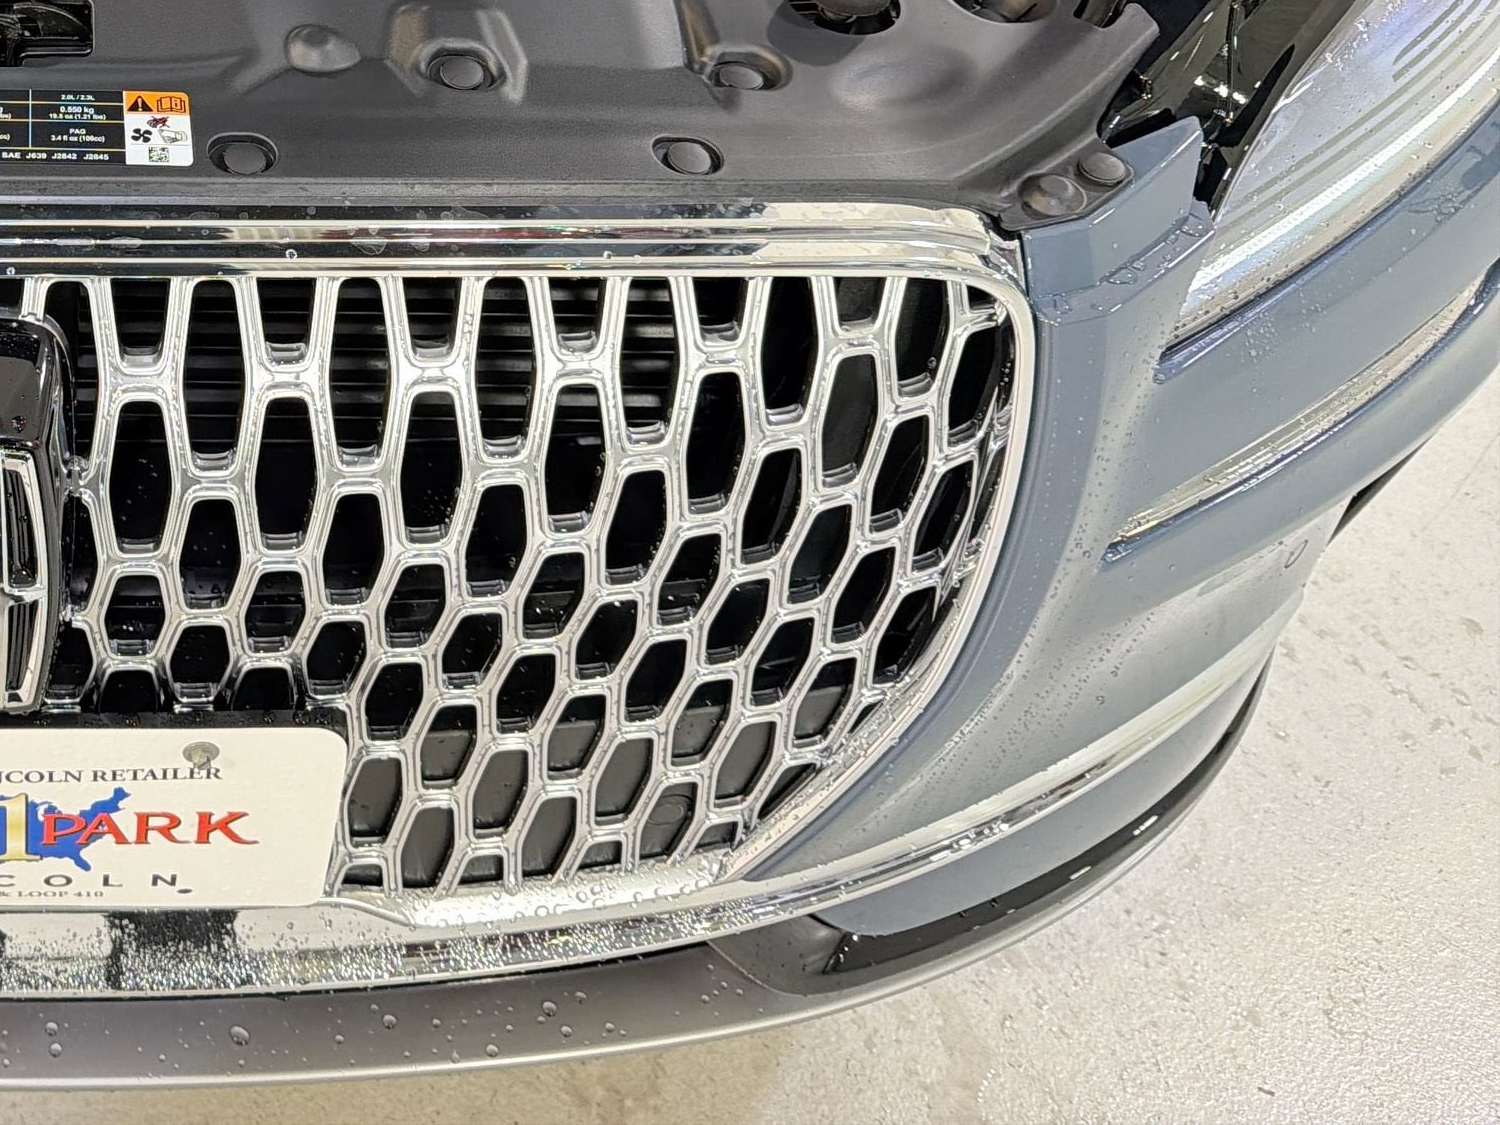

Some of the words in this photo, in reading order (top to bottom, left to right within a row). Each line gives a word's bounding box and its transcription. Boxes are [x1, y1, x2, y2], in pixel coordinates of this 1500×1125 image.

[83, 106, 95, 115] kg
[1, 151, 21, 159] SAE
[92, 766, 224, 783] RETAILER
[41, 810, 260, 846] PARK
[17, 890, 69, 898] LOOP
[73, 890, 105, 898] 410
